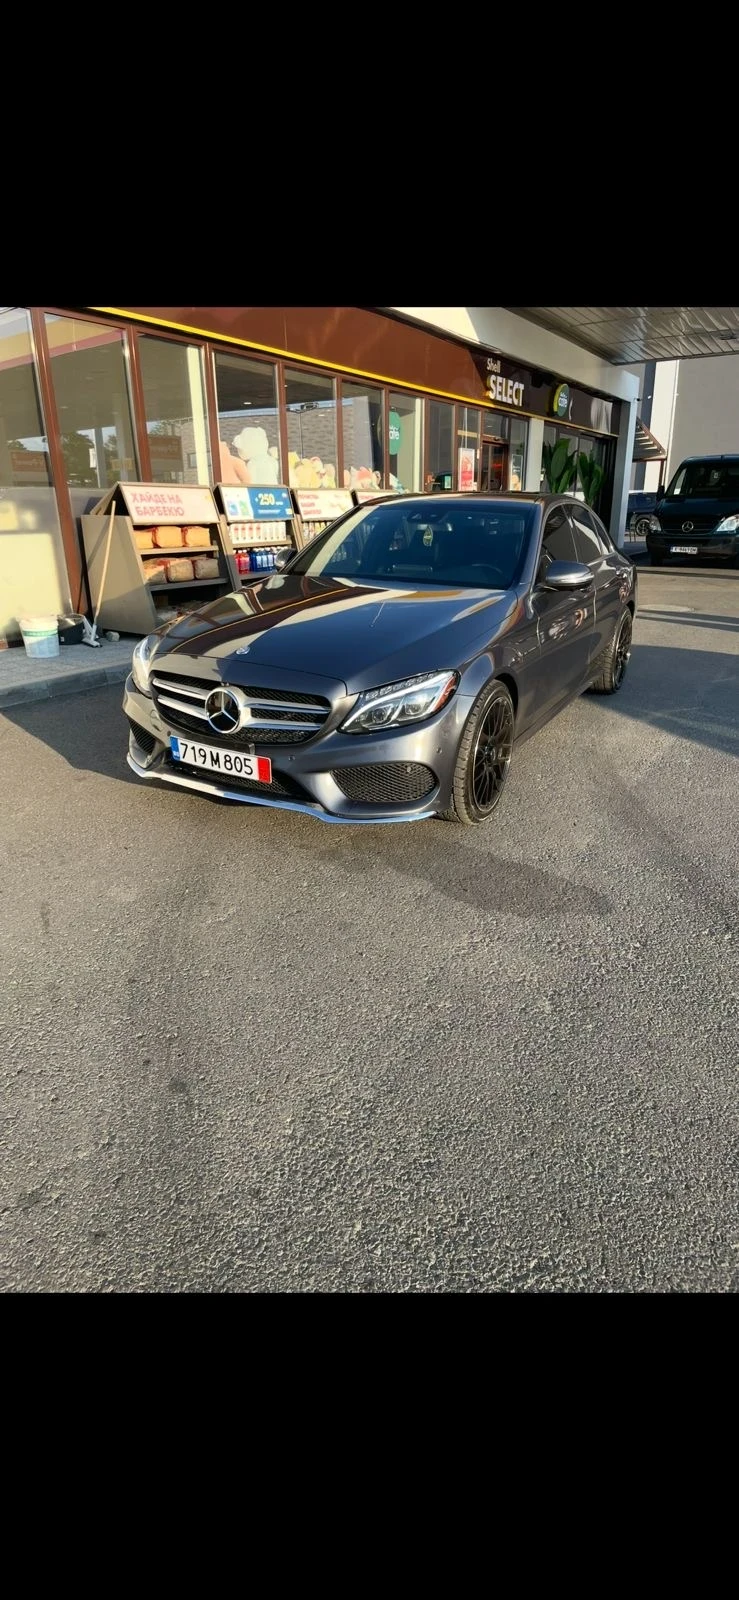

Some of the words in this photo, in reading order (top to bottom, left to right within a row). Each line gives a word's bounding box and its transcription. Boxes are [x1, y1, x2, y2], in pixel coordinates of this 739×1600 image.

[487, 358, 501, 373] Shell
[489, 375, 524, 406] SELECT
[131, 491, 166, 504] ХАЙДЕ
[168, 494, 183, 504] НА
[135, 506, 185, 517] БАРБЕКЮ
